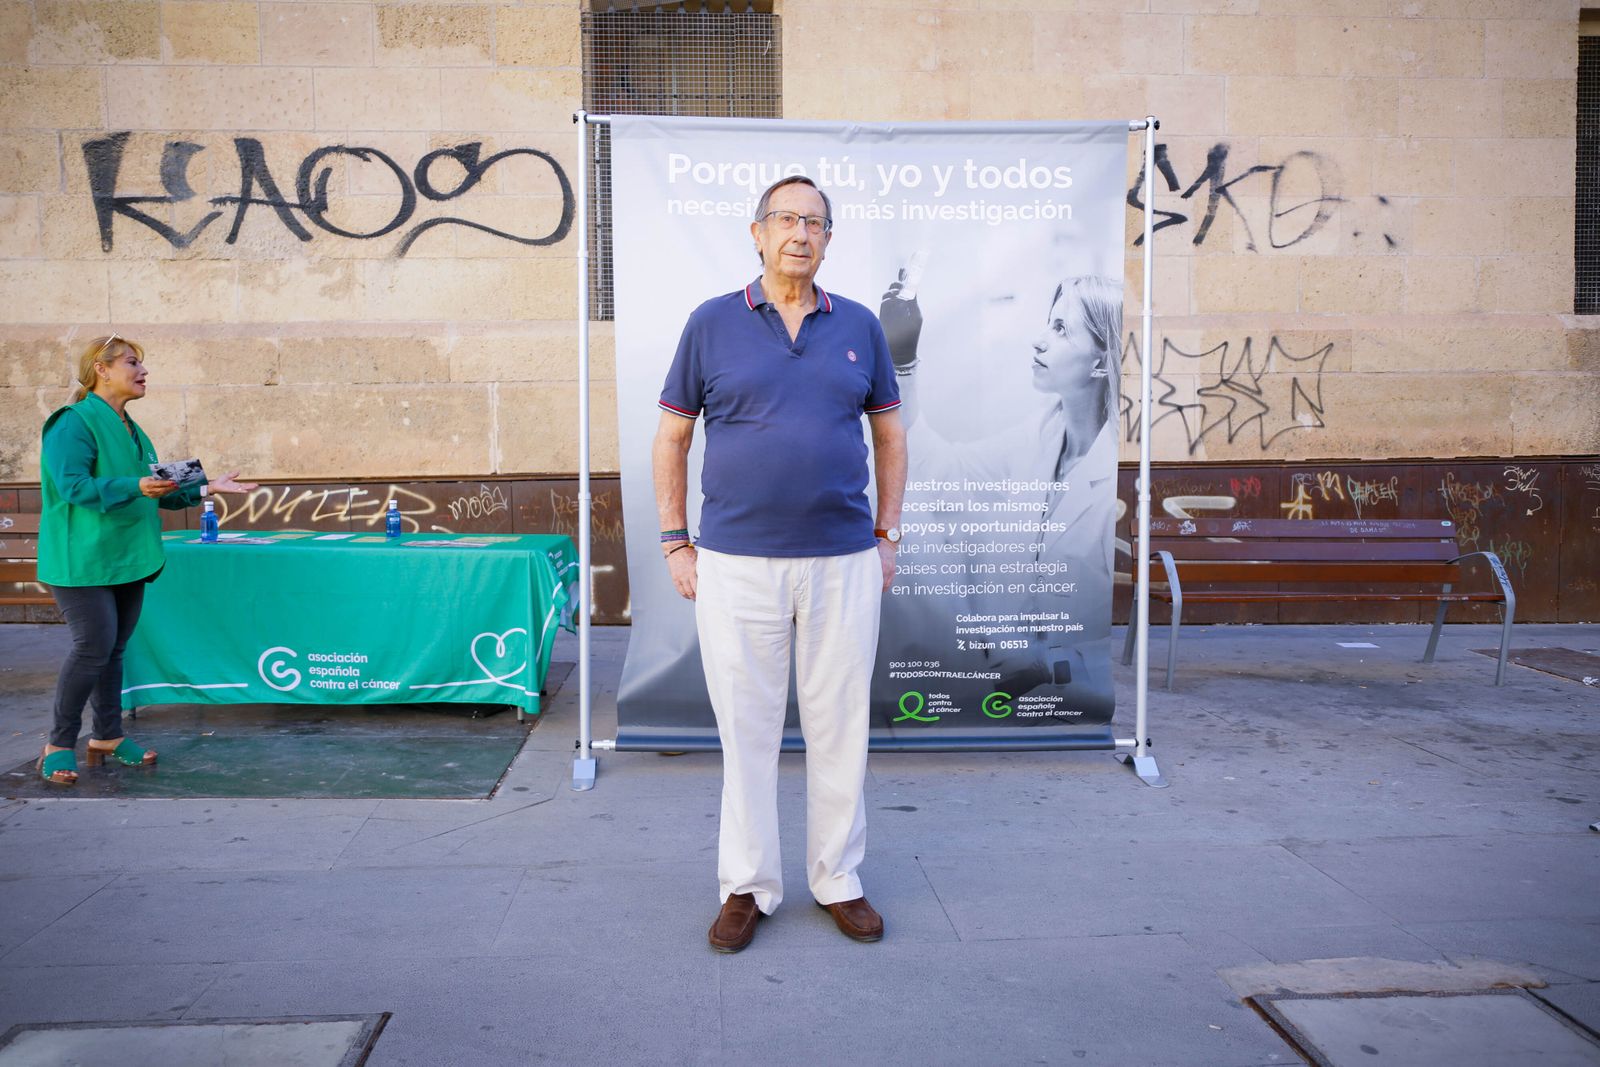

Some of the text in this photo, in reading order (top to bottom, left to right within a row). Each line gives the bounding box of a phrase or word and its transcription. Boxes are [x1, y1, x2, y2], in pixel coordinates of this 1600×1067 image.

[668, 153, 1073, 197] Porque tú, yo y todos
[841, 199, 895, 222] más
[902, 199, 1073, 226] investigación
[904, 478, 1070, 494] uestros investigadores
[902, 499, 1049, 512] ecesitan los mismos
[901, 520, 1067, 536] poyos y oportunidades
[923, 540, 1025, 556] investigadores
[1028, 542, 1046, 553] en
[940, 563, 966, 574] con
[970, 562, 996, 573] una
[1000, 560, 1068, 575] estrategia
[891, 580, 1078, 598] en investigación en cáncer.
[956, 612, 1070, 623] Colabora para impulsar la
[956, 625, 1015, 635] investigación
[1030, 624, 1063, 632] nuestro
[1065, 622, 1084, 633] país
[969, 639, 1029, 650] bizum 06513
[307, 652, 368, 663] asociación
[889, 661, 906, 669] 900
[924, 660, 940, 669] 036
[308, 666, 360, 677] española
[309, 678, 401, 690] contra el cáncer
[1017, 703, 1056, 711] española
